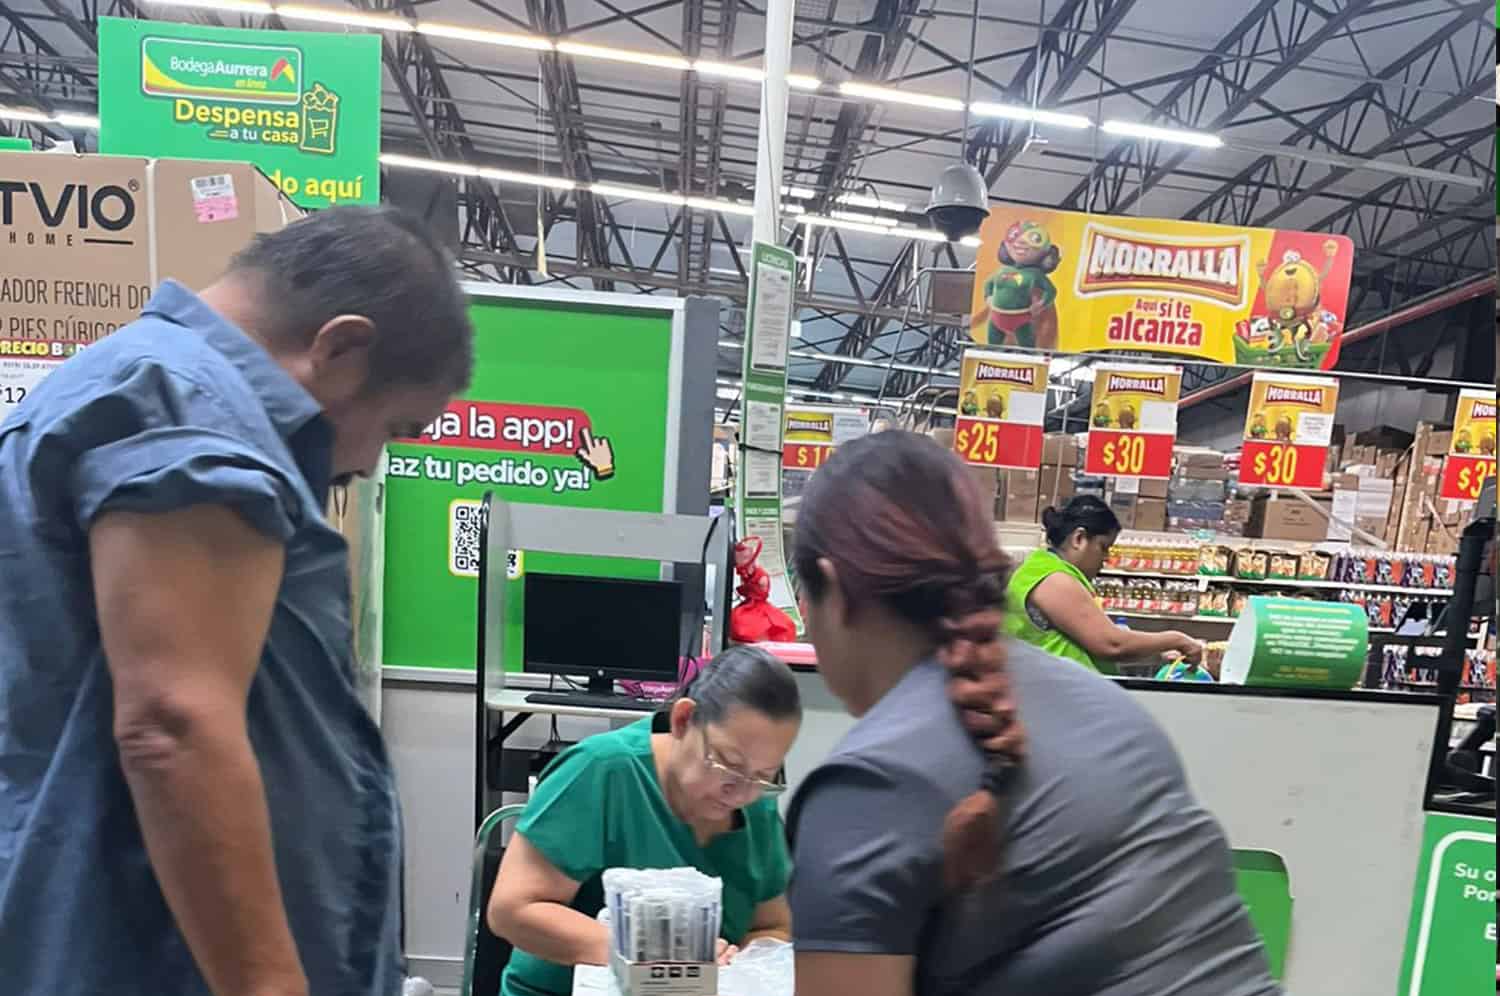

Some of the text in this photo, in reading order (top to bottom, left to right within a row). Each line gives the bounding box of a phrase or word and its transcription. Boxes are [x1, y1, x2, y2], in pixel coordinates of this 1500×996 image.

[175, 99, 300, 128] Despensa
[230, 127, 299, 143] a tu casa
[305, 175, 363, 203] aquí
[9, 231, 73, 247] HOME
[1089, 233, 1238, 286] MORRALLA
[54, 280, 121, 309] FRENCH
[1176, 300, 1192, 319] te
[1109, 310, 1202, 346] alcanza
[979, 364, 1034, 384] MORRALLA
[1110, 375, 1164, 393] MORRALLA
[1267, 387, 1322, 405] MORRALLA
[470, 406, 495, 438] la
[503, 416, 574, 448] app!
[957, 421, 1000, 463] $25
[1103, 434, 1146, 474] $30
[425, 456, 451, 480] tu
[457, 459, 548, 485] pedido
[554, 466, 591, 492] ya!
[1253, 445, 1298, 484] $30
[1454, 862, 1480, 880] Su
